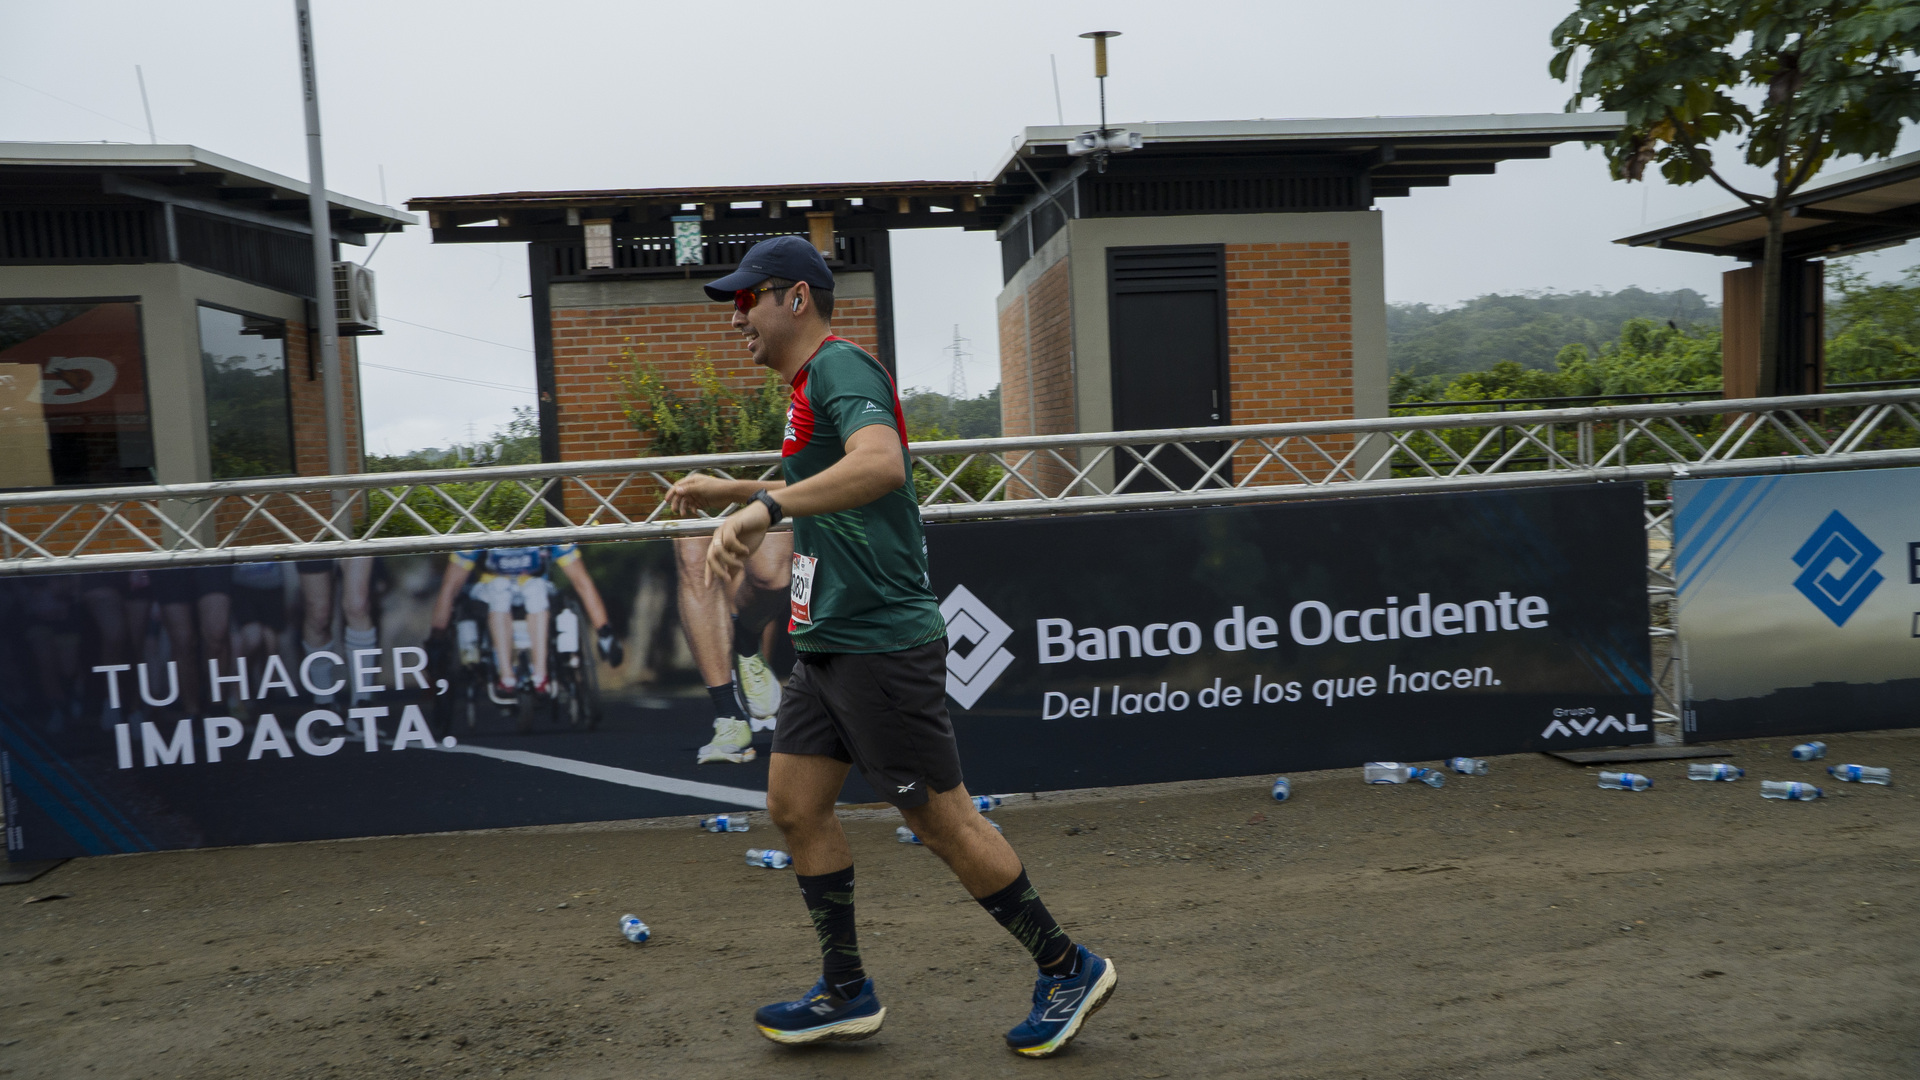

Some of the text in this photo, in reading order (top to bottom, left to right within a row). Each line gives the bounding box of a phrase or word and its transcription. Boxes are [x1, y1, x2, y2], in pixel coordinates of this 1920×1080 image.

[1036, 591, 1549, 664] Banco de Occidente
[92, 646, 450, 709] TU HACER,
[1042, 660, 1502, 721] Del lado de los que hacen.
[114, 704, 458, 769] IMPACTA.
[1540, 712, 1649, 740] AVAL
[1552, 706, 1596, 718] Grupo
